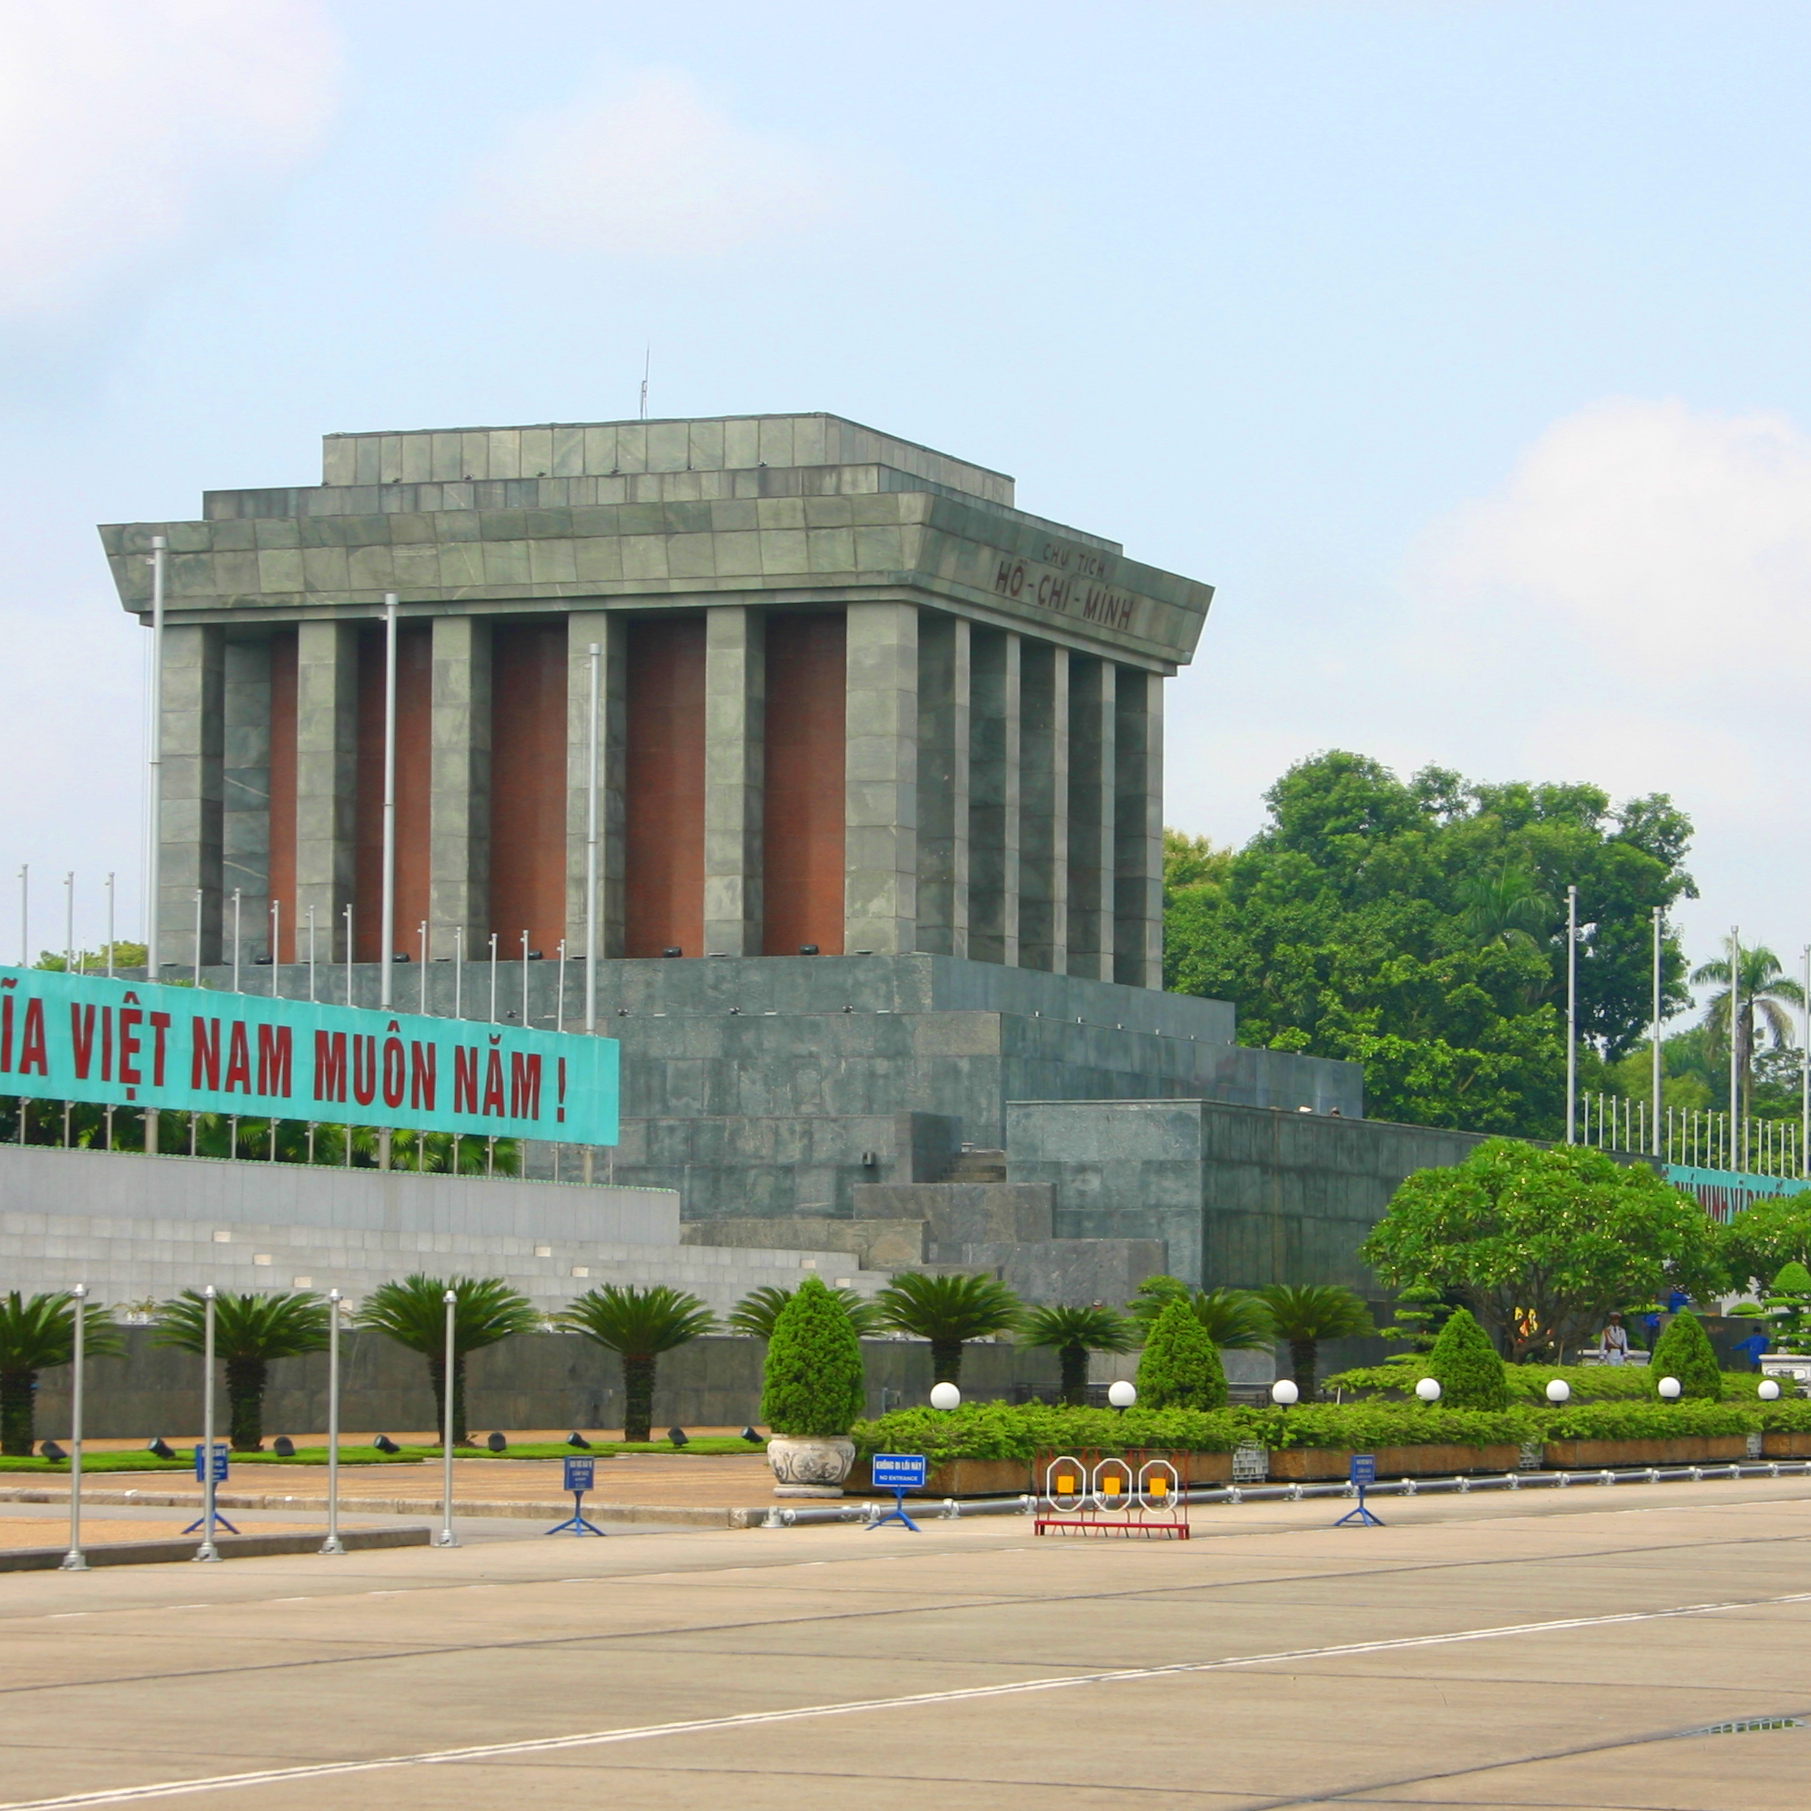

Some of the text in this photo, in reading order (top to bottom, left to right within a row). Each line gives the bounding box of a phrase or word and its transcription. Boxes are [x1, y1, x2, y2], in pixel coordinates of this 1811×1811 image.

[70, 991, 171, 1100] VIỆT
[191, 1016, 292, 1098] NAM
[314, 1020, 436, 1111] MUÔN
[454, 1033, 541, 1120] NĂM
